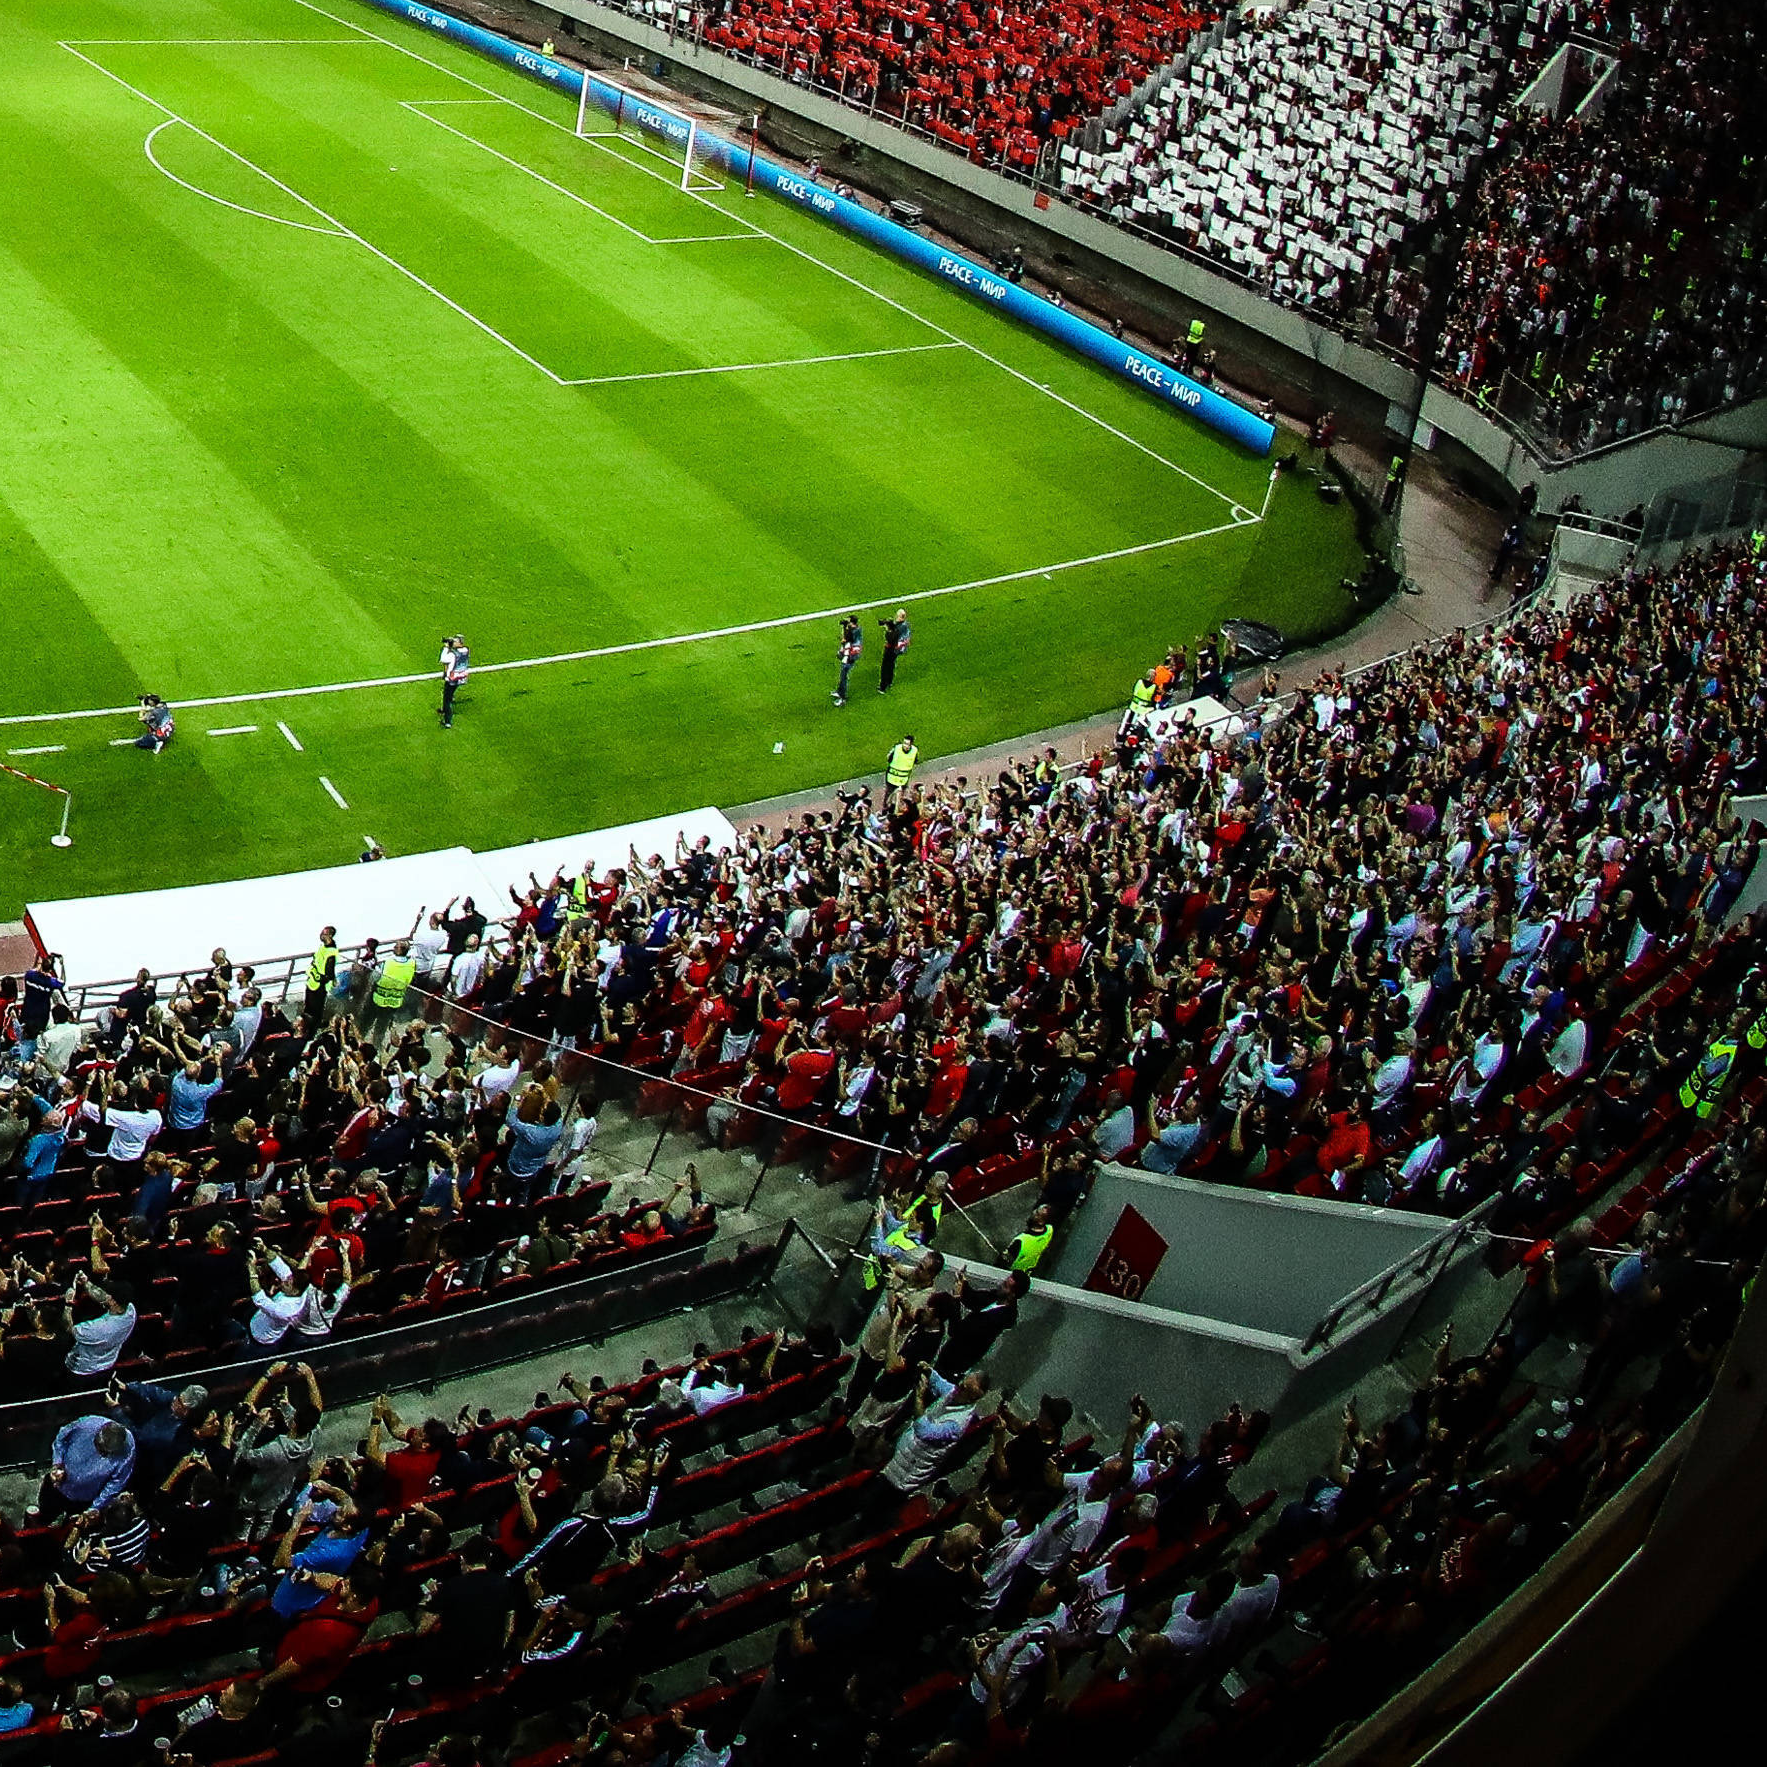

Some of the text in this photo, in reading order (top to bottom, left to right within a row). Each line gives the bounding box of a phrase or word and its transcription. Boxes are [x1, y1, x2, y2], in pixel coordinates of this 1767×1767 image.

[514, 51, 538, 69] PEACE
[636, 107, 663, 130] PEACE
[776, 175, 807, 199] PEACE
[938, 256, 972, 284] PEACE
[1125, 354, 1164, 387] PEACE
